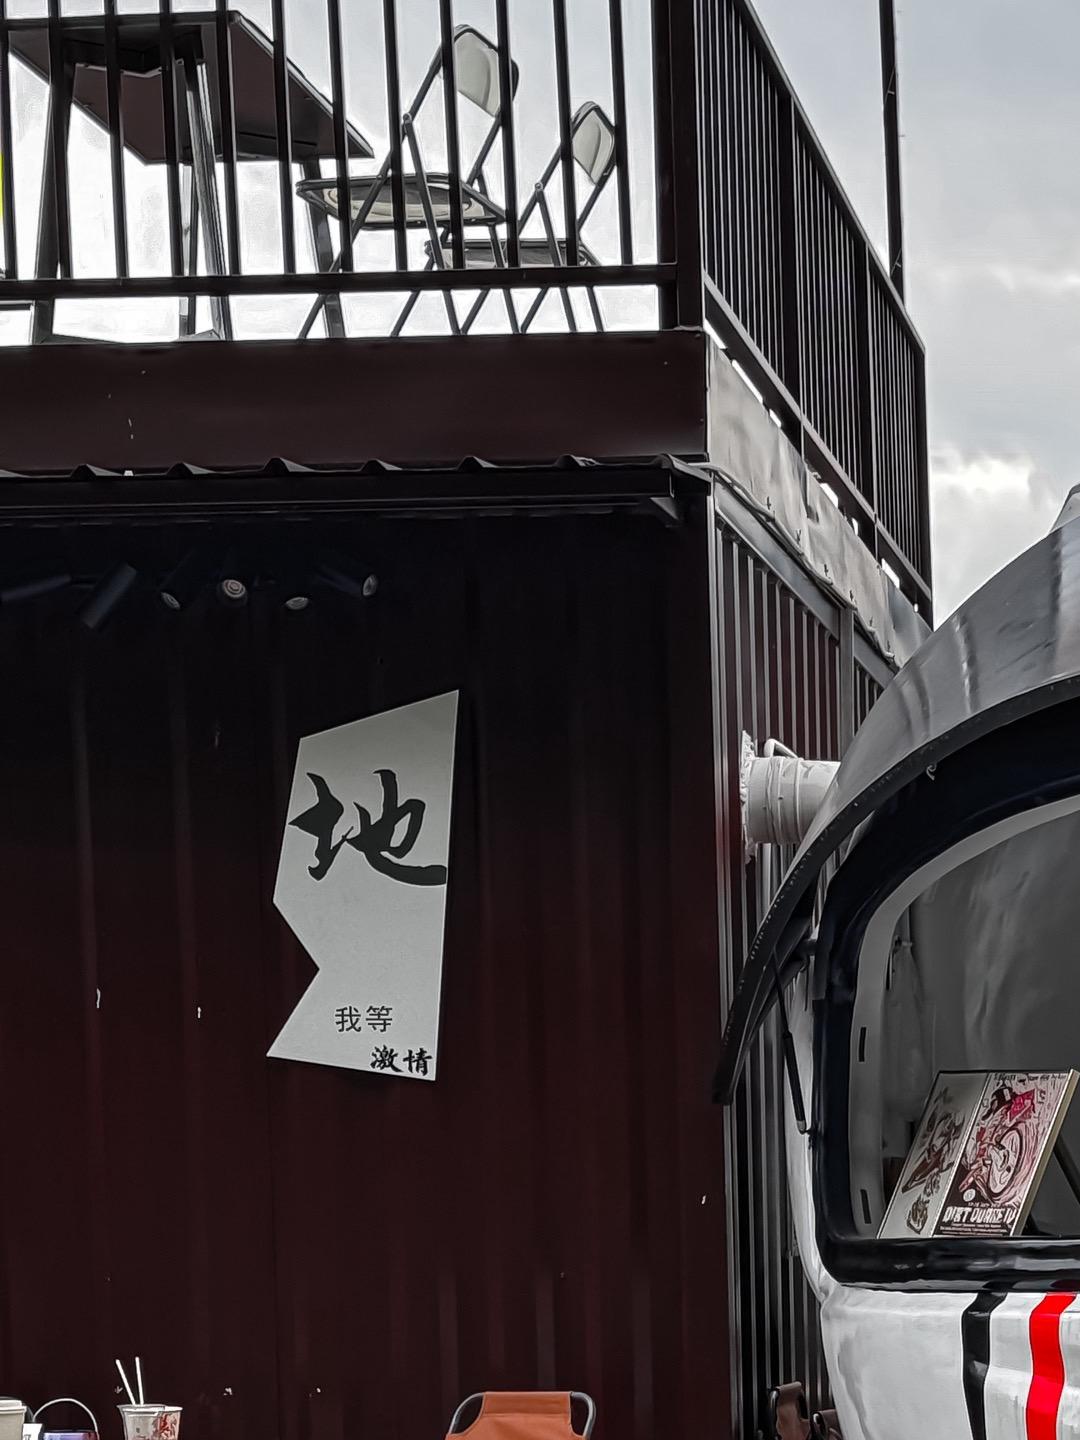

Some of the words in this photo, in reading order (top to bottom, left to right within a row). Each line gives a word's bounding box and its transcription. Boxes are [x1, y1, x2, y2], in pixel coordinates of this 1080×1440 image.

[288, 769, 447, 886] 地
[334, 1005, 394, 1034] 我等
[369, 1045, 433, 1077] 激情
